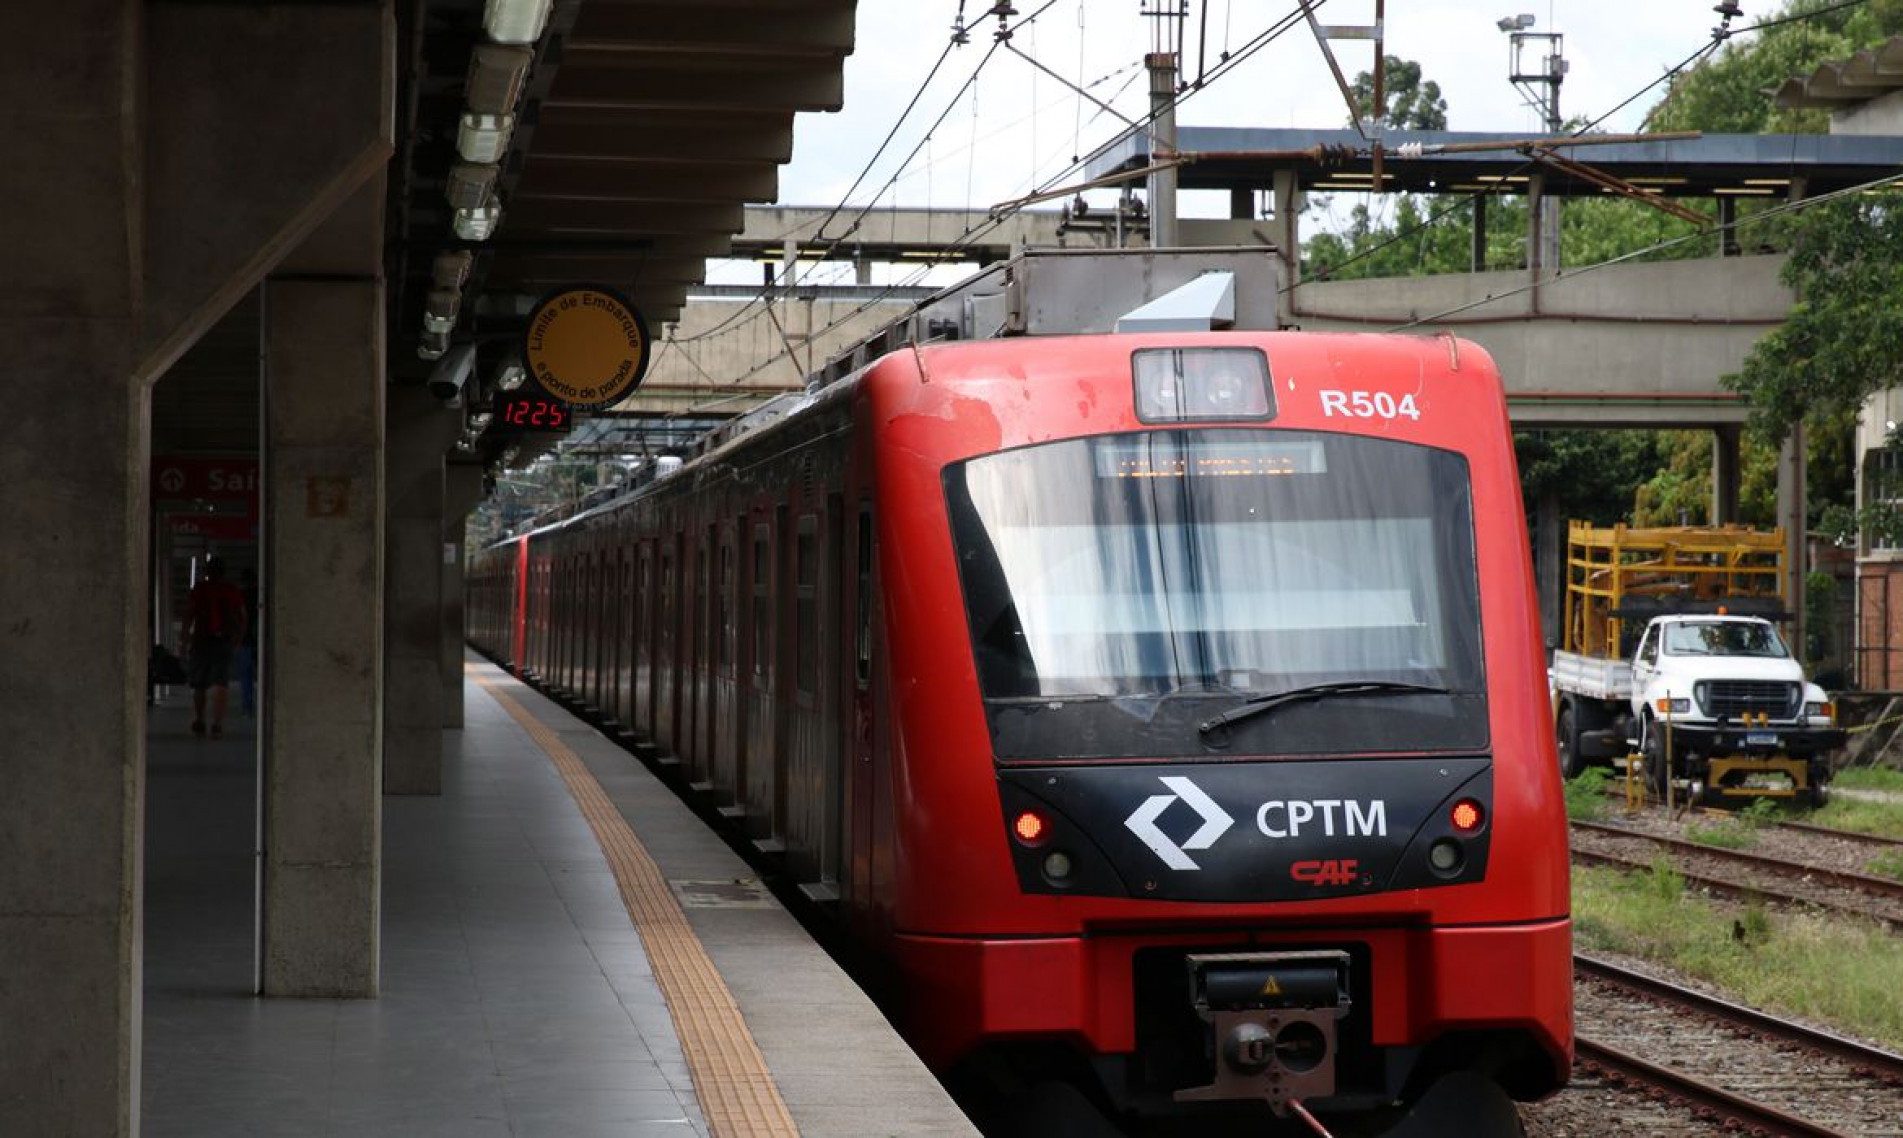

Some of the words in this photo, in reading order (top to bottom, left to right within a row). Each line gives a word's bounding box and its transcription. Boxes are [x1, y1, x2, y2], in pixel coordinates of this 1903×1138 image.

[531, 308, 558, 351] Limite
[560, 296, 578, 310] de
[583, 293, 639, 349] Embarque
[542, 371, 576, 396] ponto
[579, 387, 596, 399] de
[600, 359, 632, 396] parada
[1320, 390, 1421, 421] R504
[207, 467, 258, 492] Saí
[1256, 799, 1387, 838] CPTM
[1291, 859, 1358, 886] CAF
